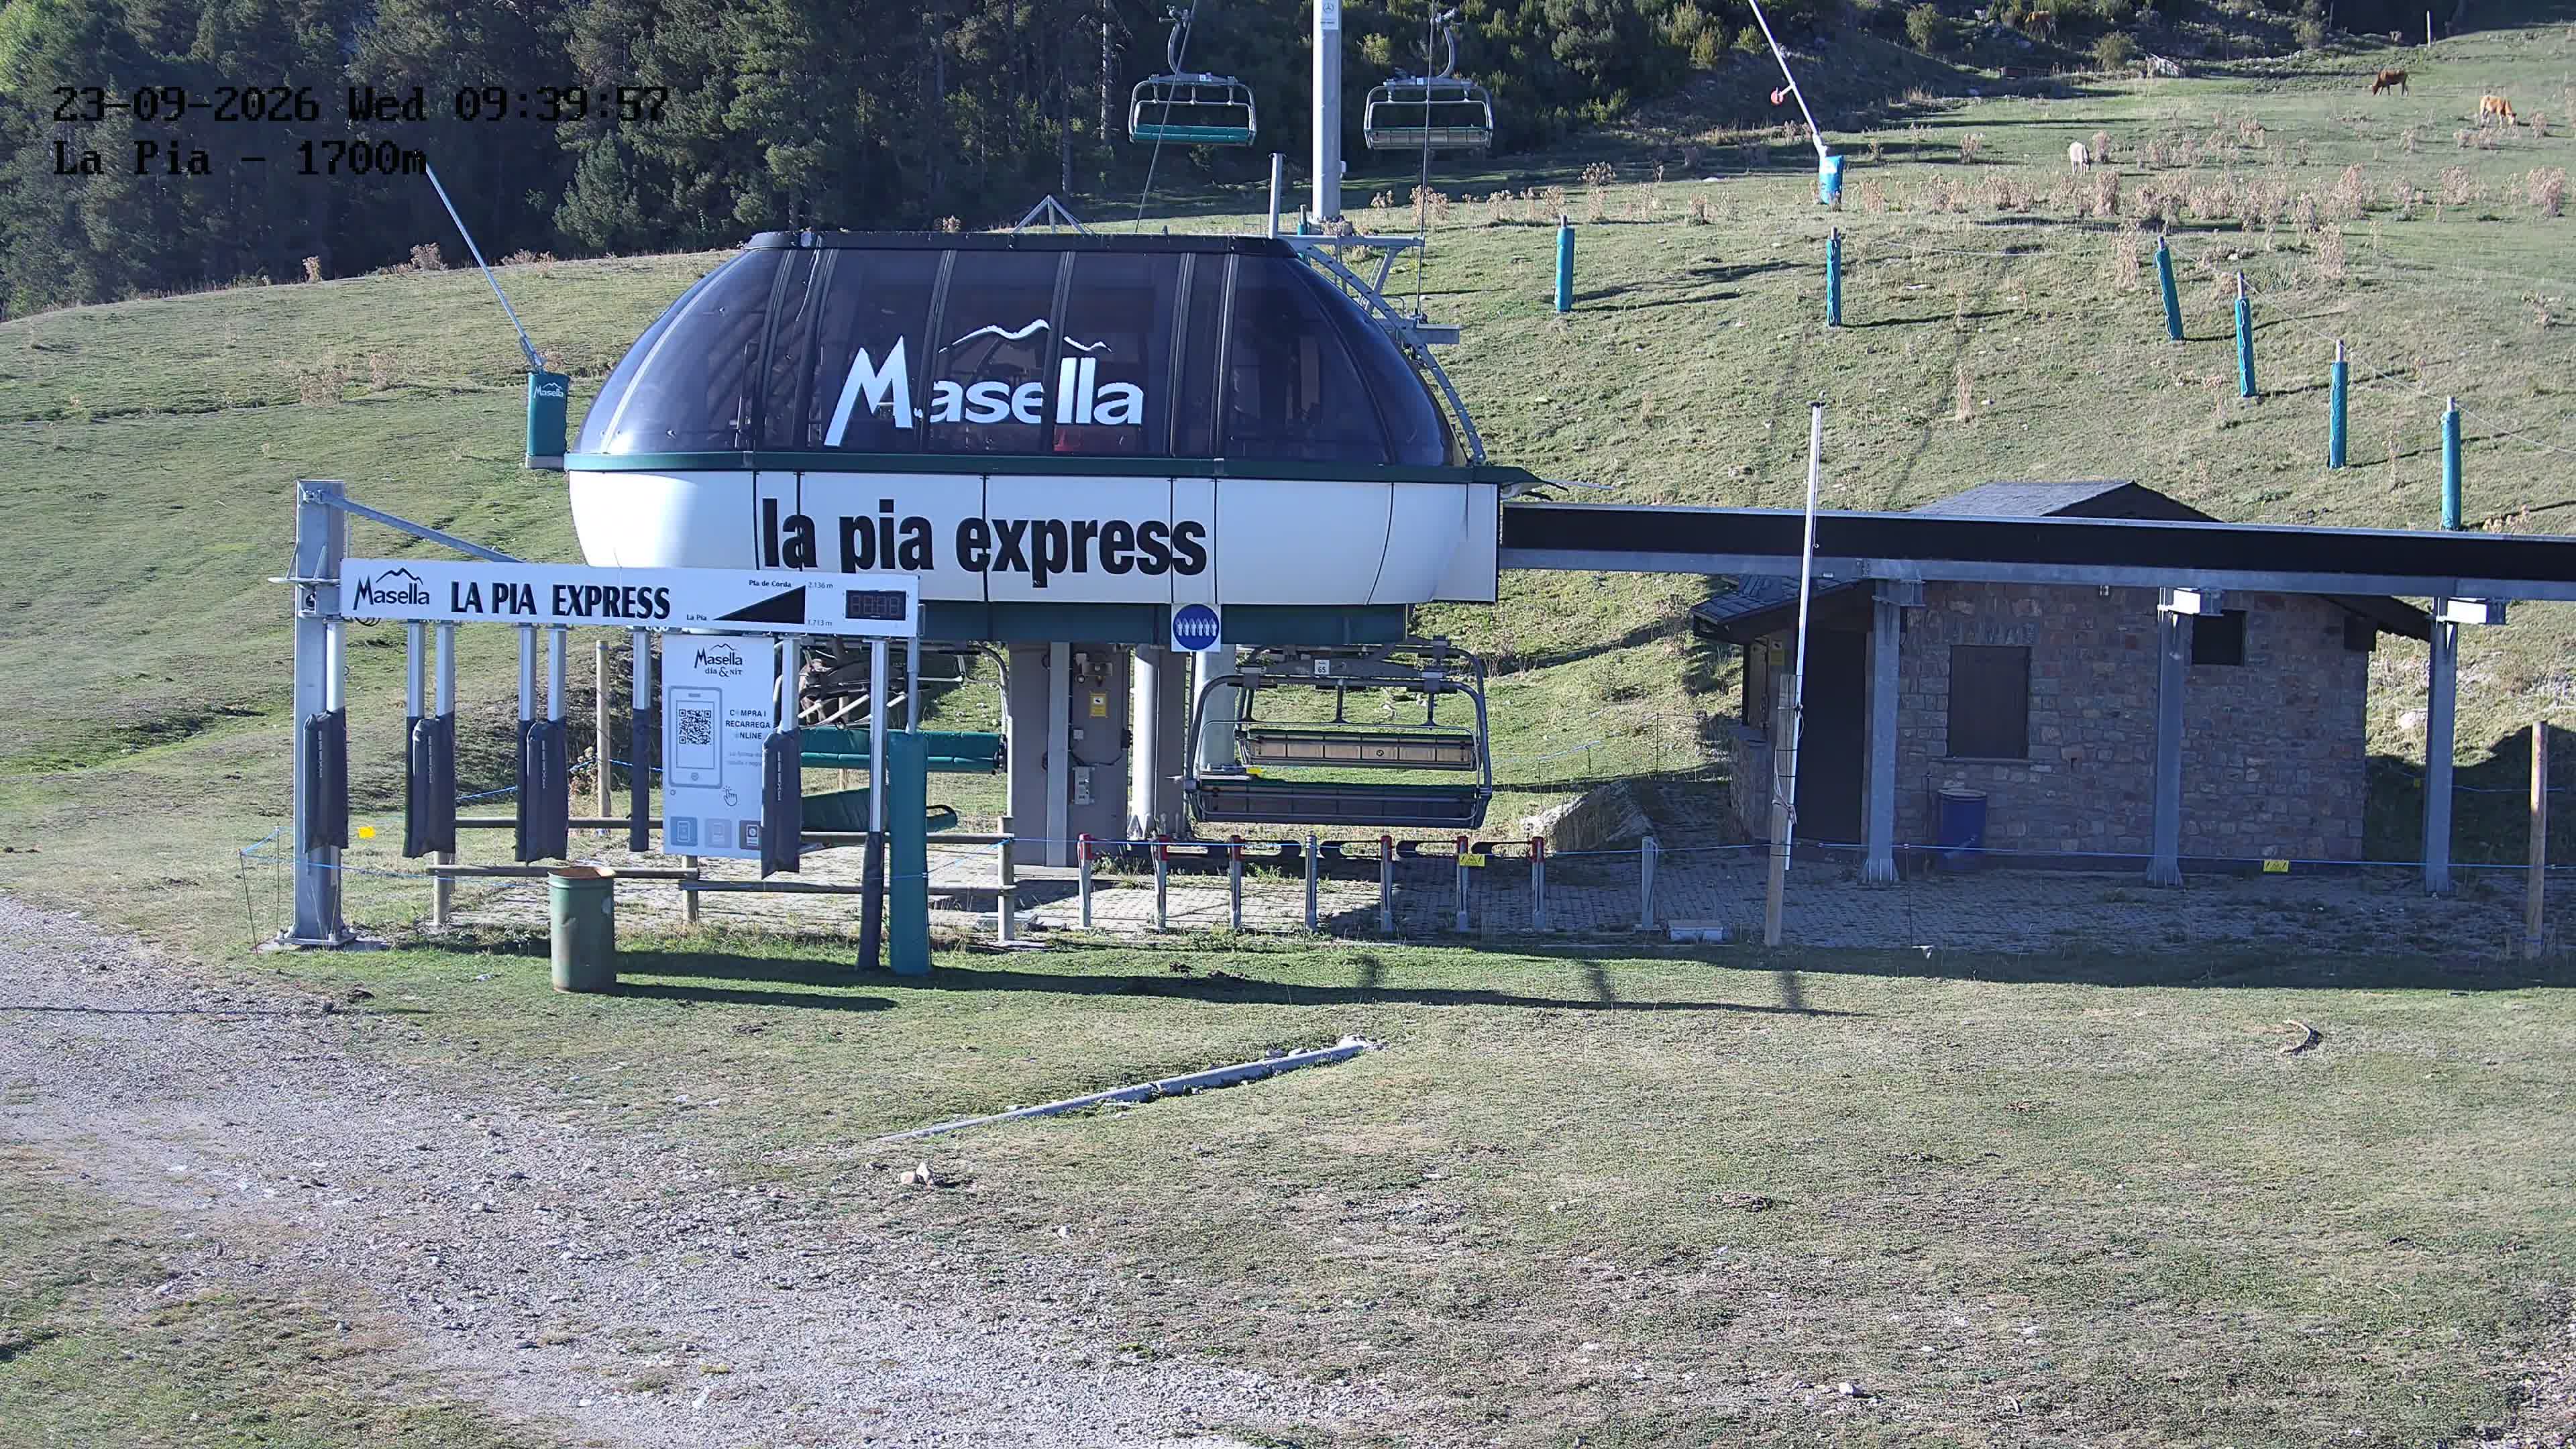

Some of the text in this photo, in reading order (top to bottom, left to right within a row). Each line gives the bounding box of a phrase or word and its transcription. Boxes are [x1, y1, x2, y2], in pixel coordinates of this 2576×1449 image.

[533, 384, 564, 398] Masella
[824, 335, 1144, 447] Masella
[762, 498, 1208, 588] la pia express
[353, 575, 430, 610] Masella
[451, 581, 671, 619] LA PIA EXPRESS
[694, 647, 743, 668] Masella
[718, 666, 730, 678] &
[729, 709, 763, 717] CMPRA
[725, 720, 771, 729] RECARREGA
[735, 732, 762, 740] NLINE
